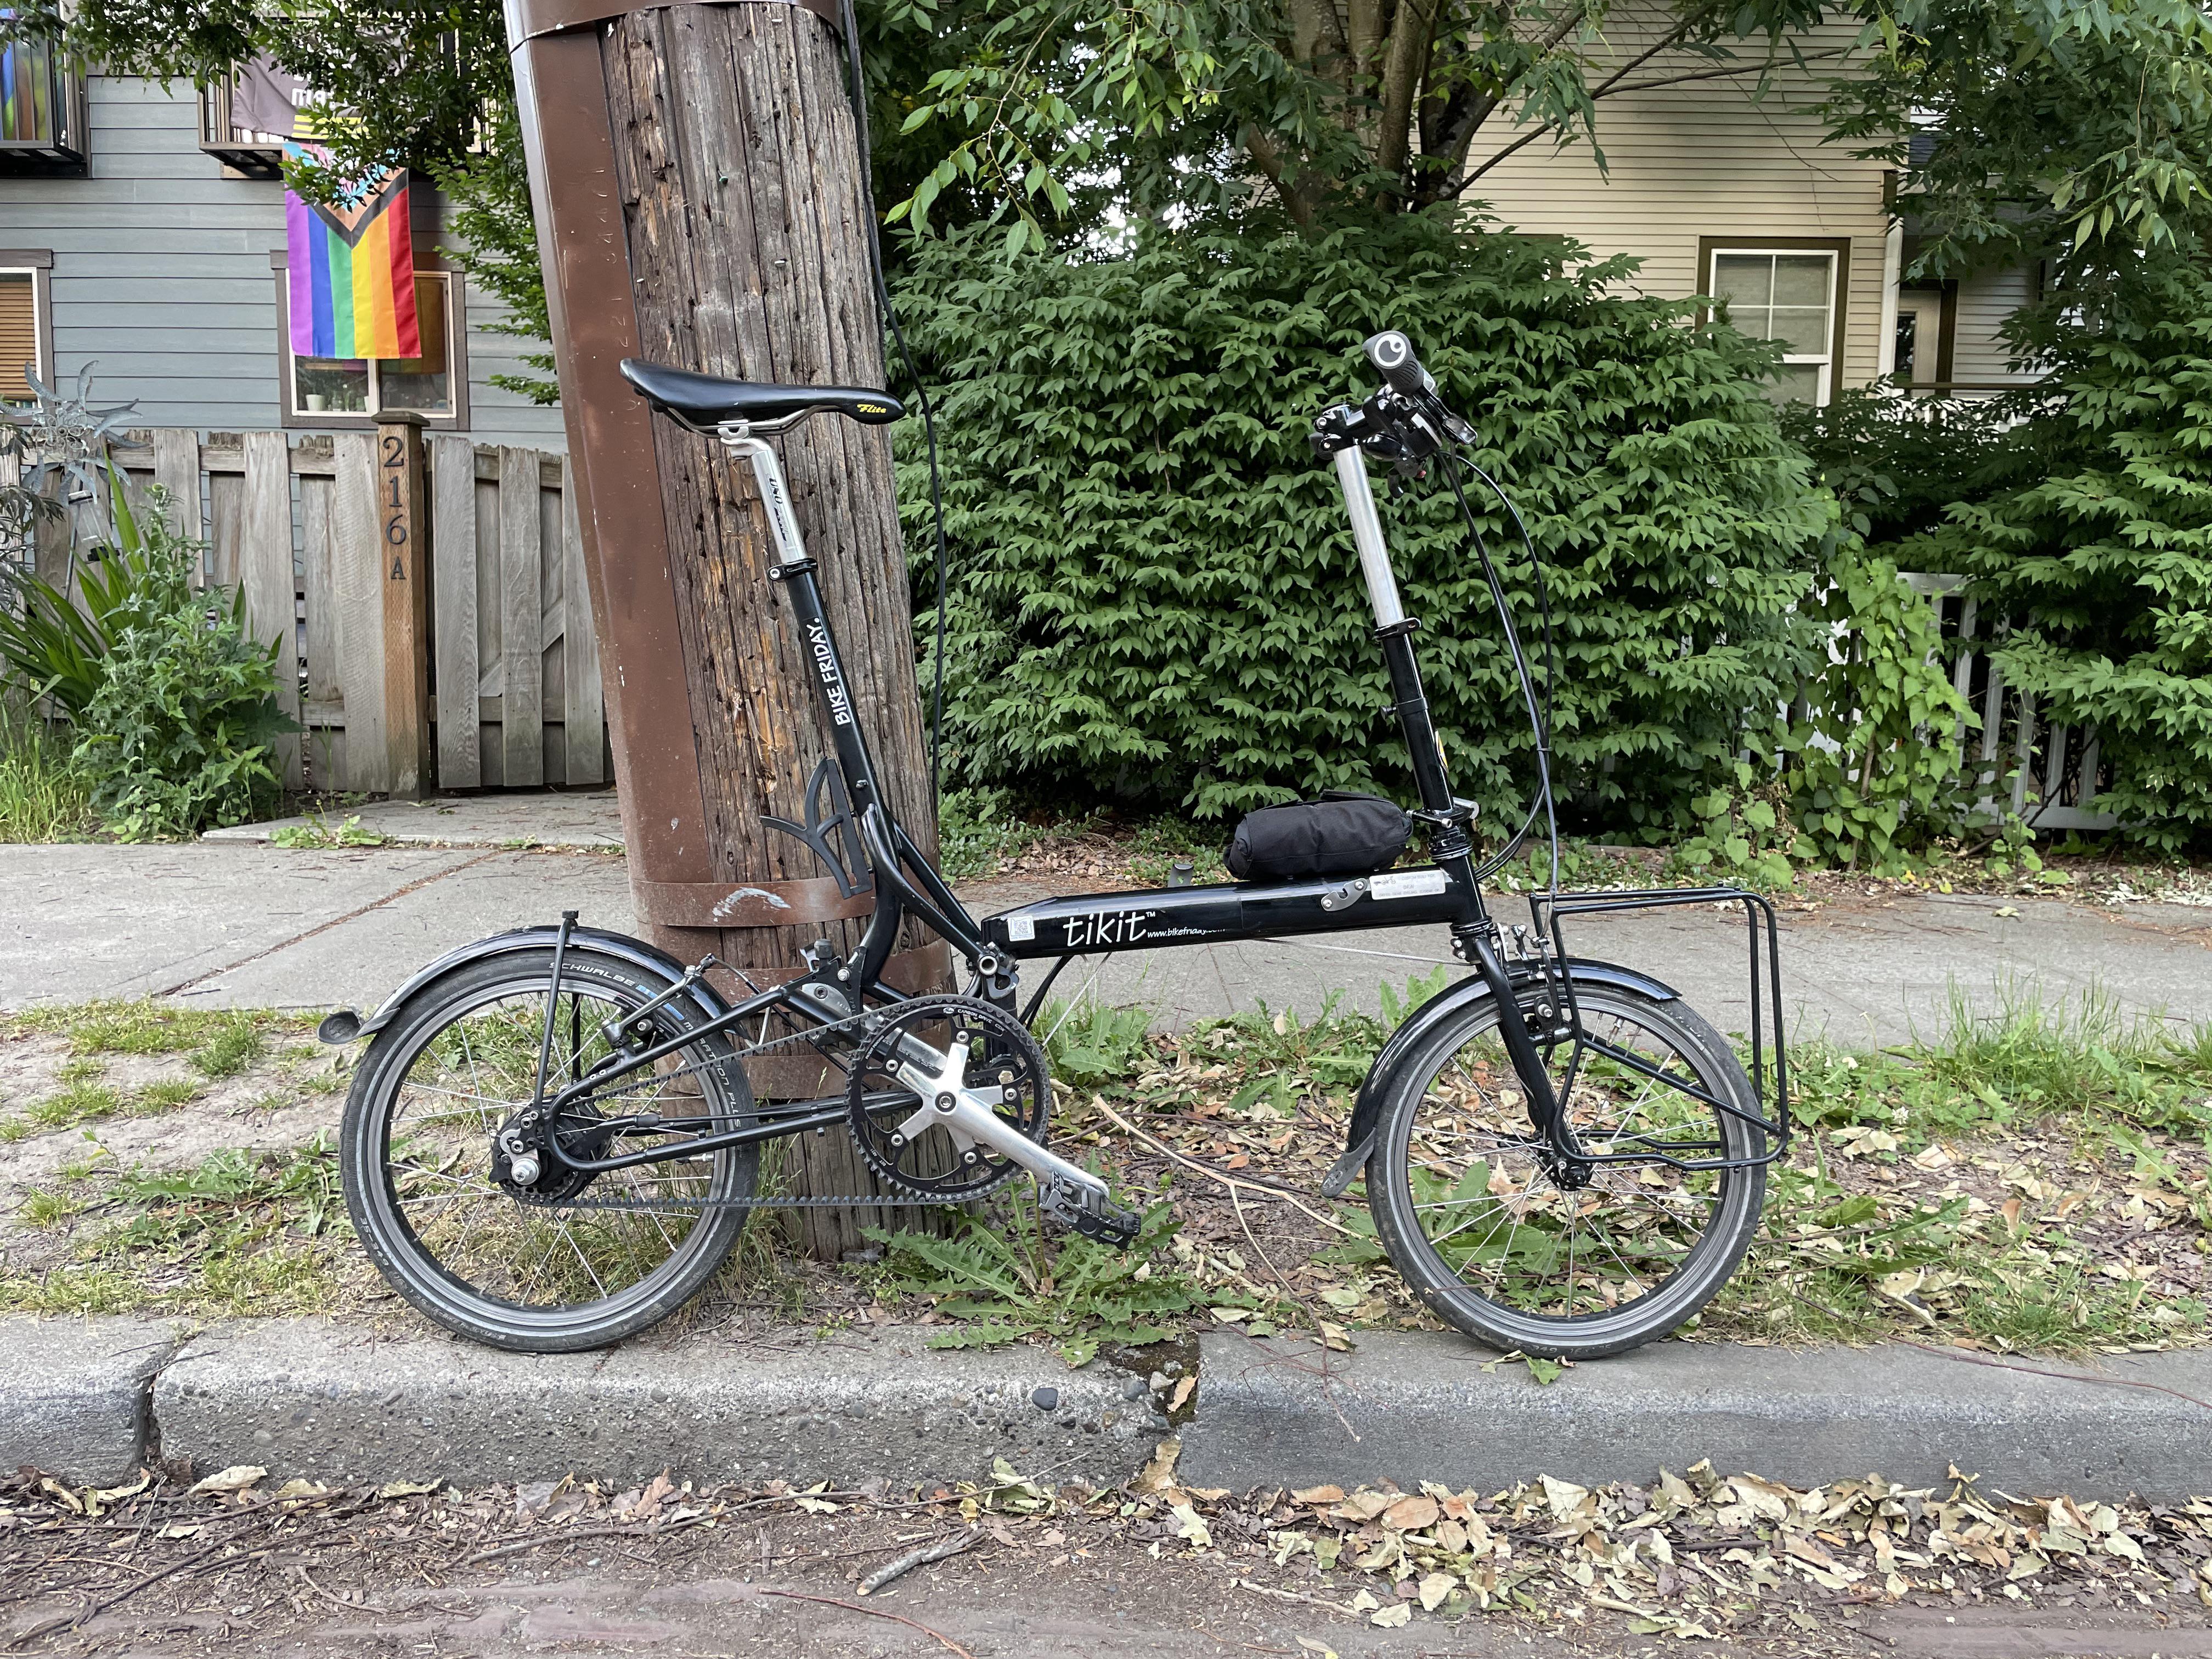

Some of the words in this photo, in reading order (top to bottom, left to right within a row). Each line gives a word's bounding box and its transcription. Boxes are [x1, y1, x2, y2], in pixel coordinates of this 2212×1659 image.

[857, 404, 887, 413] Flite
[827, 685, 851, 725] BIKE
[1063, 910, 1147, 947] tikit
[1147, 927, 1225, 938] www.bikefriday.
[549, 962, 635, 987] SCHWALBE
[957, 1009, 978, 1017] CARBON
[978, 1014, 993, 1024] DRIVE
[684, 1022, 730, 1086] MRATON
